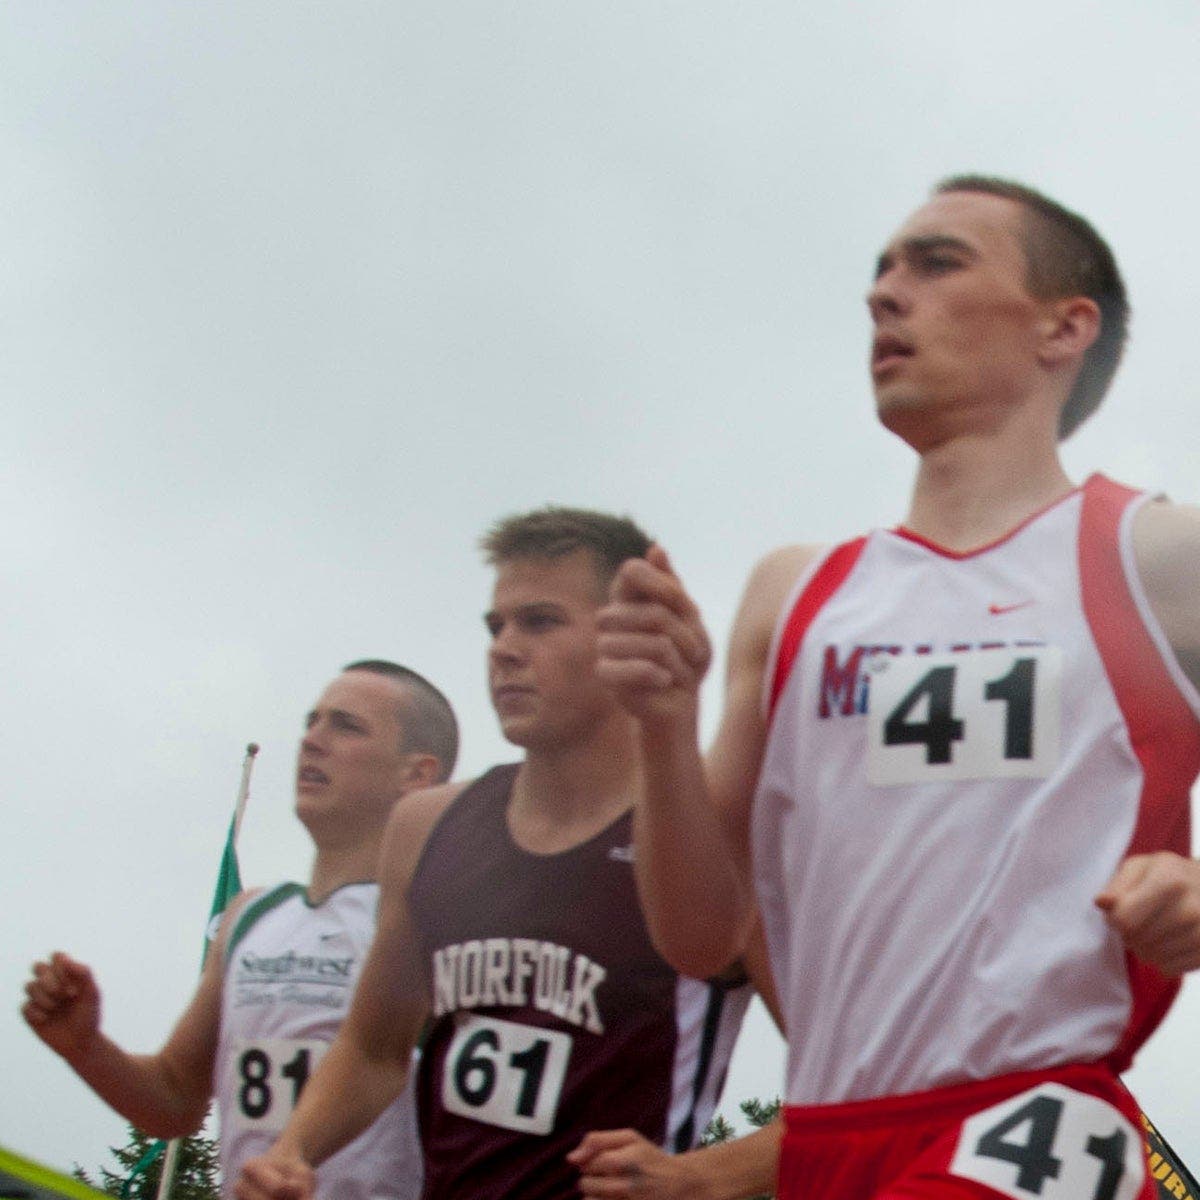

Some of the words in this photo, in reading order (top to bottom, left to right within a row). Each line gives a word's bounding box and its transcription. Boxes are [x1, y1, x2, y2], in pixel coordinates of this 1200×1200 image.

[882, 657, 1037, 765] 41
[433, 937, 606, 1034] NORFOLK
[454, 1029, 551, 1118] 61
